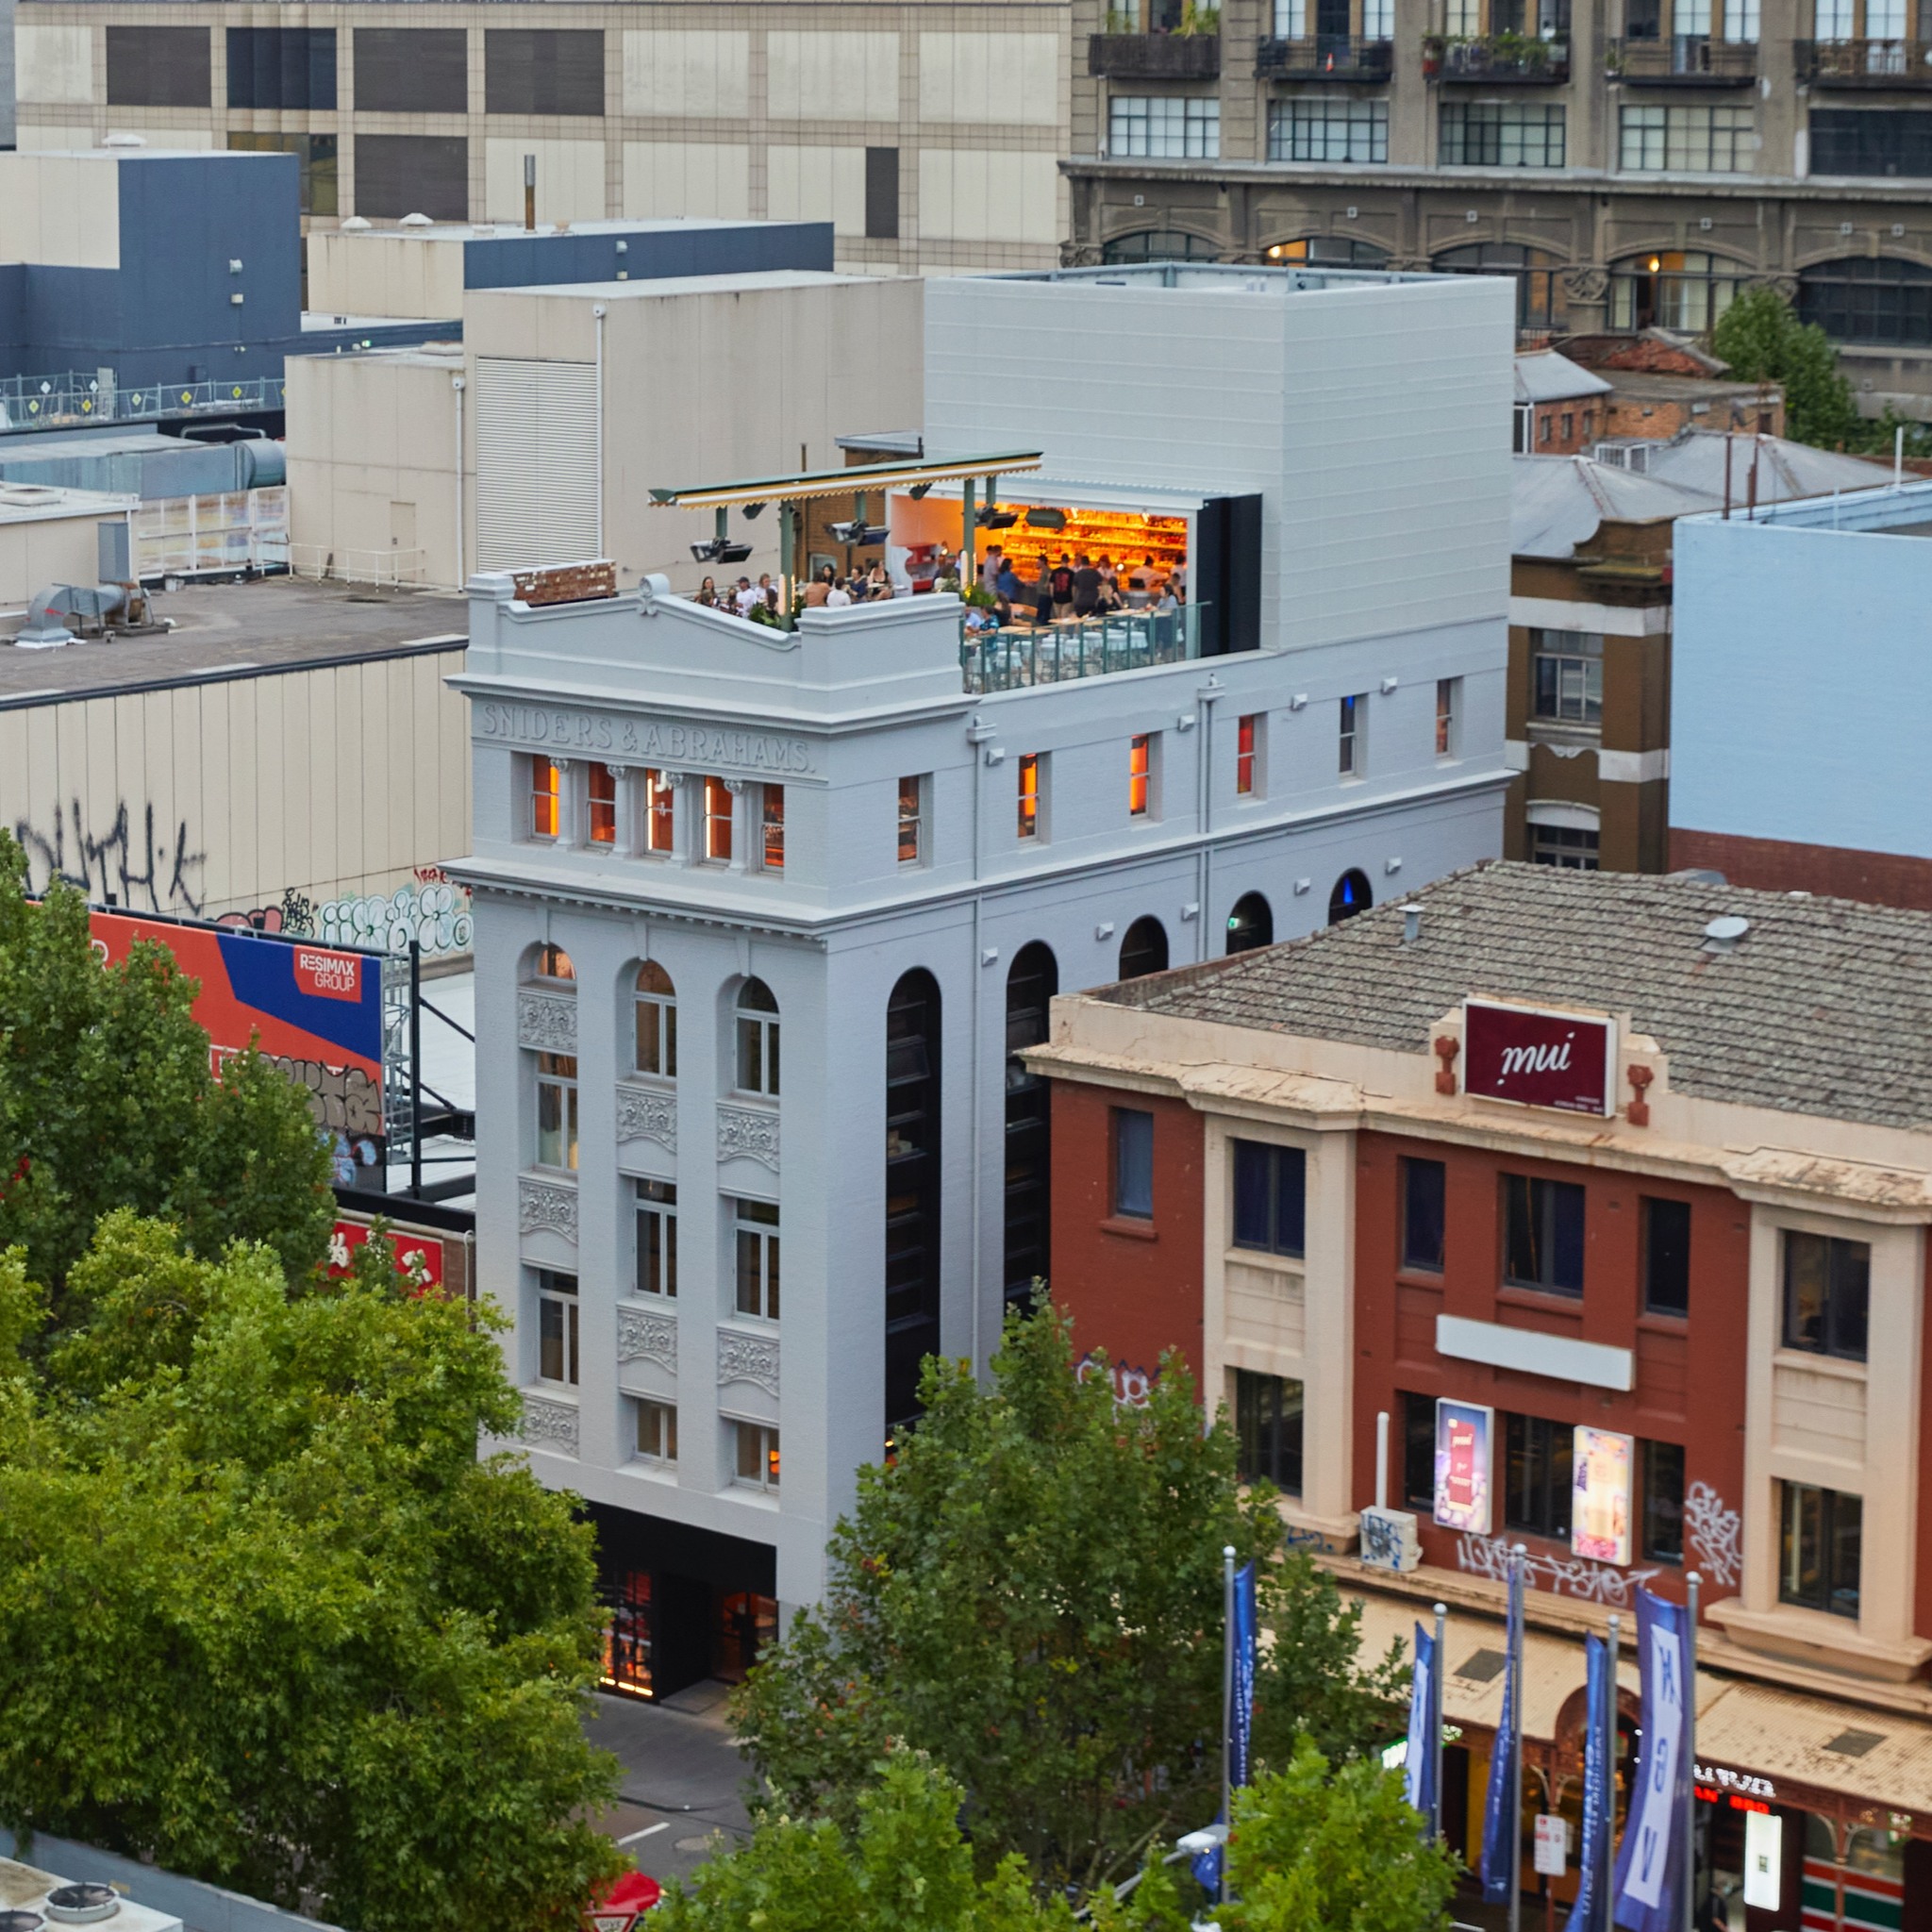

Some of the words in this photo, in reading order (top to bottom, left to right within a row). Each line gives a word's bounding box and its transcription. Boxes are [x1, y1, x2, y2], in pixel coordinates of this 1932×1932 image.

[483, 706, 612, 749] SNIDERS
[623, 721, 639, 752] &
[300, 953, 355, 976] RESIMAX
[314, 972, 356, 991] GROUP
[1500, 1031, 1575, 1076] mui
